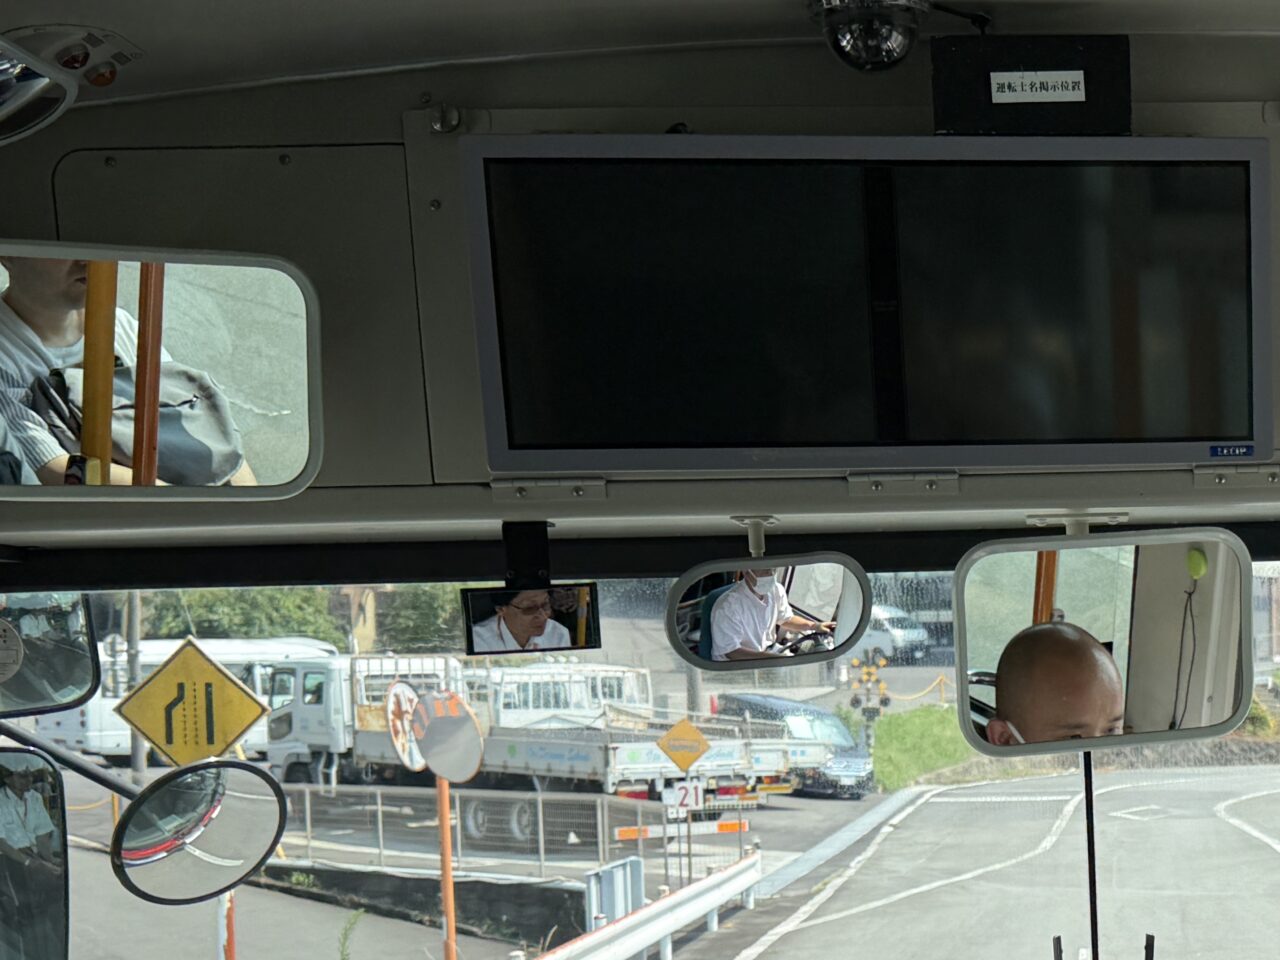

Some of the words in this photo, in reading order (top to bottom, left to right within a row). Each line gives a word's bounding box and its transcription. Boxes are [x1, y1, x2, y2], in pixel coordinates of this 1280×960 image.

[996, 80, 1082, 93] 運転士名掲示位置
[678, 785, 701, 808] 21
